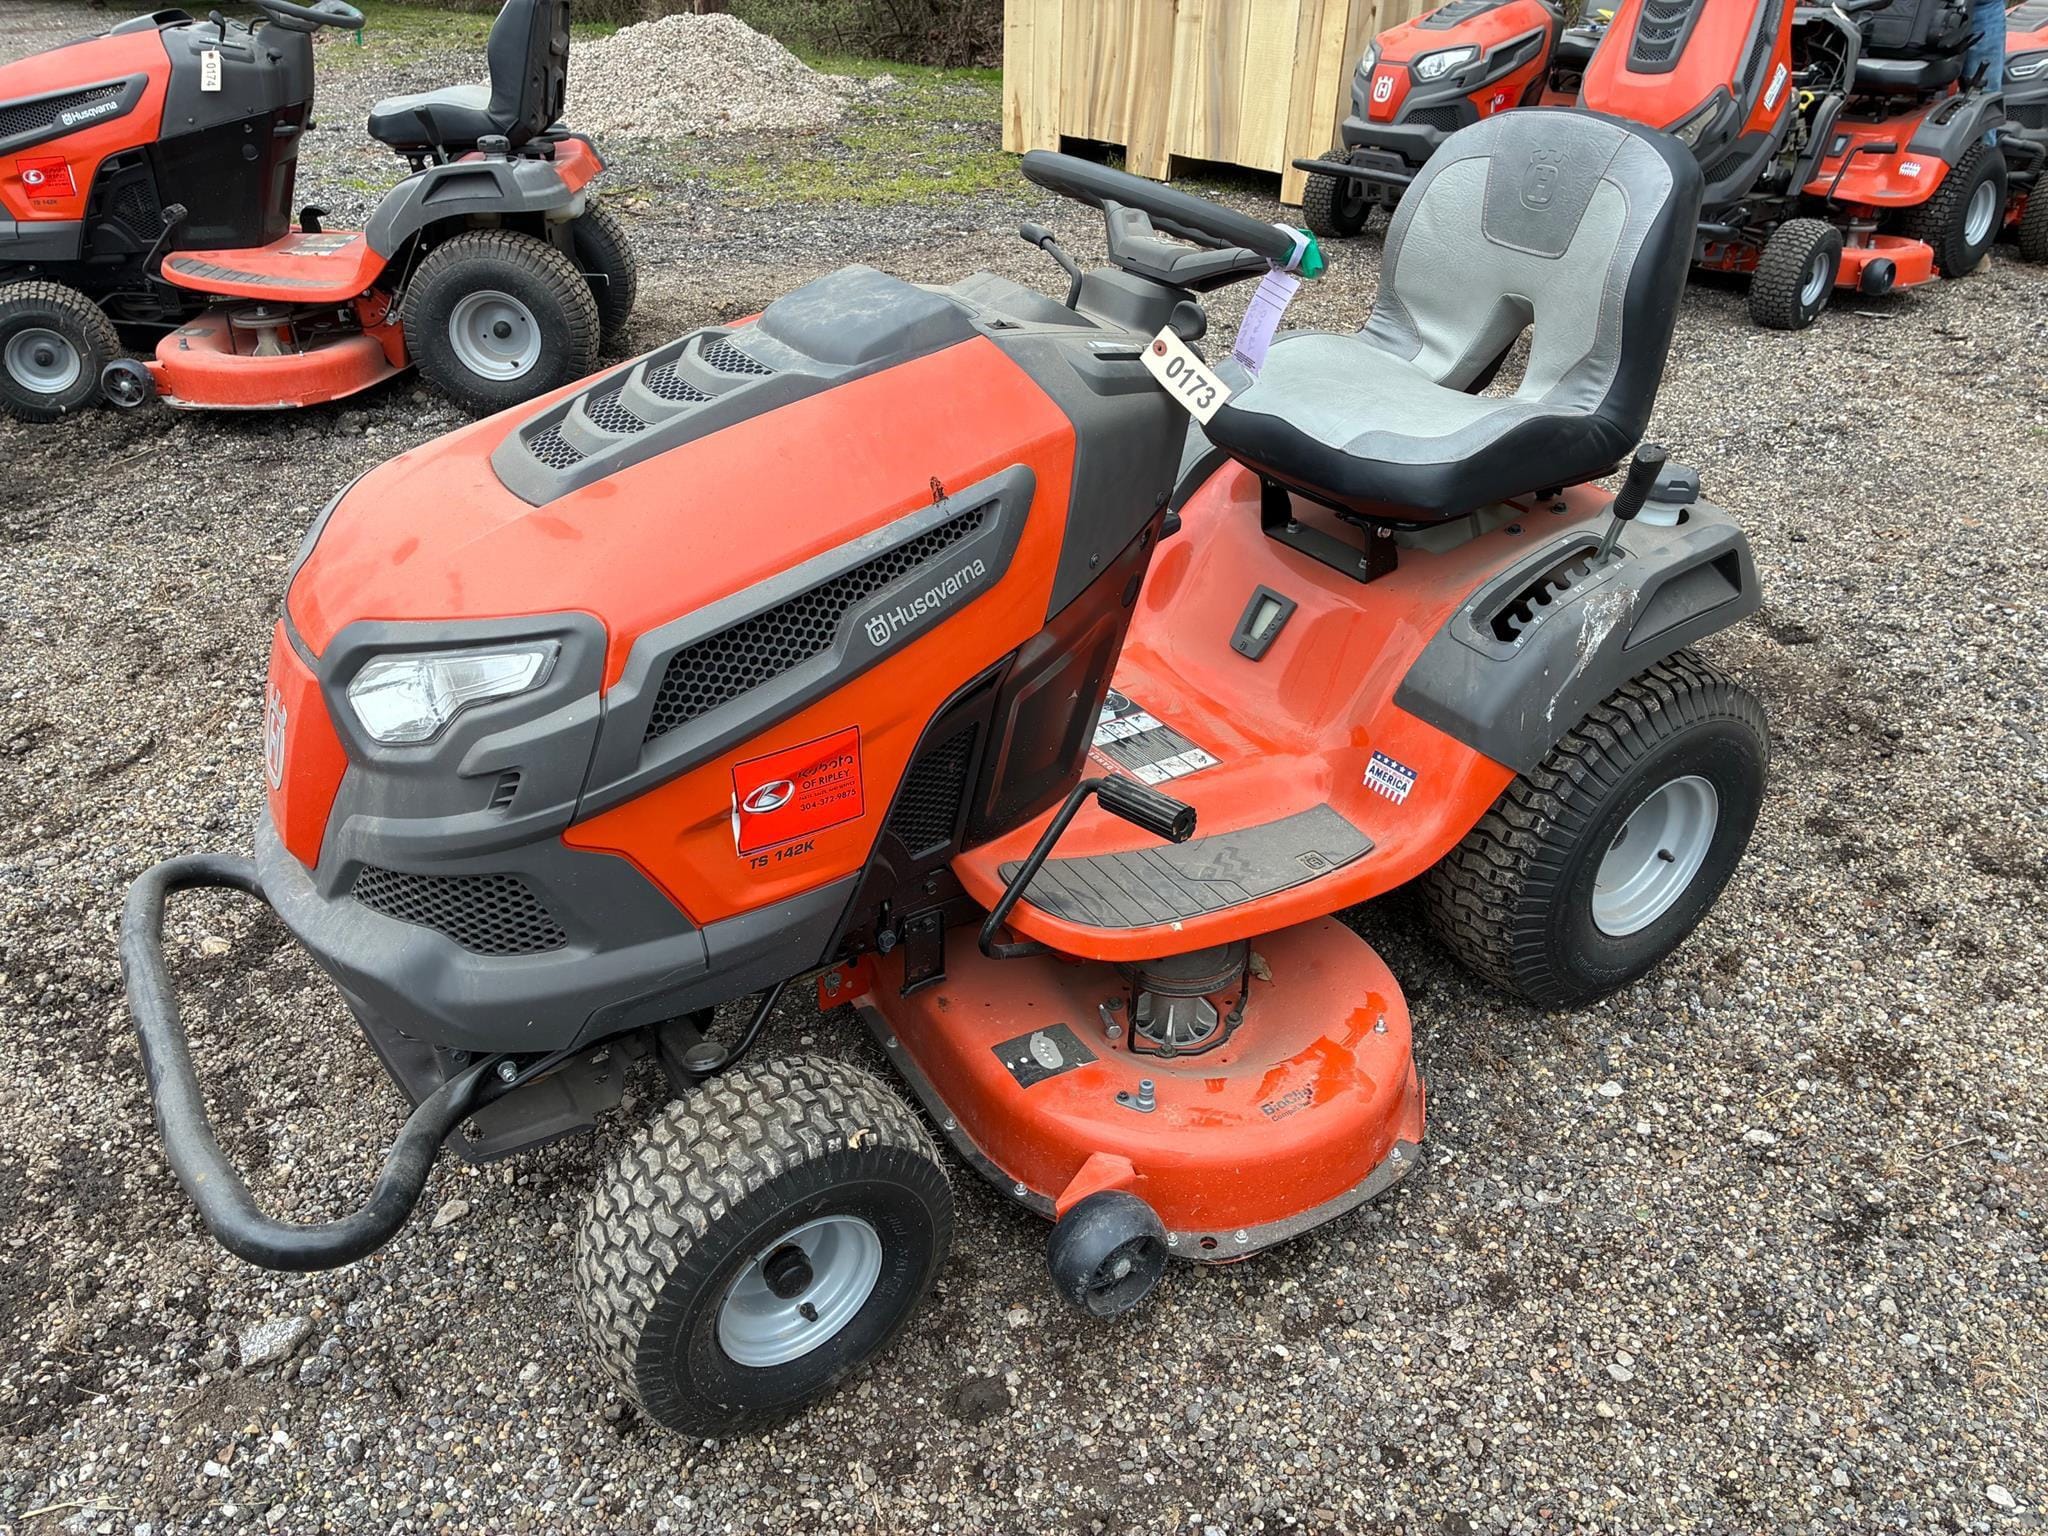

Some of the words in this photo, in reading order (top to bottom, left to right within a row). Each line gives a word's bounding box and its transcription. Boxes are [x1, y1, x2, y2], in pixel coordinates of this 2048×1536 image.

[206, 62, 216, 86] 0174
[72, 101, 118, 122] Husqvarna
[1165, 355, 1216, 410] 0173
[887, 558, 986, 632] Husqvarna
[802, 779, 816, 790] OF
[818, 769, 850, 785] RIPLEY
[1368, 764, 1408, 793] AMERICA
[800, 789, 857, 811] 304-372-9875
[750, 855, 768, 870] TS
[774, 840, 815, 861] 142K
